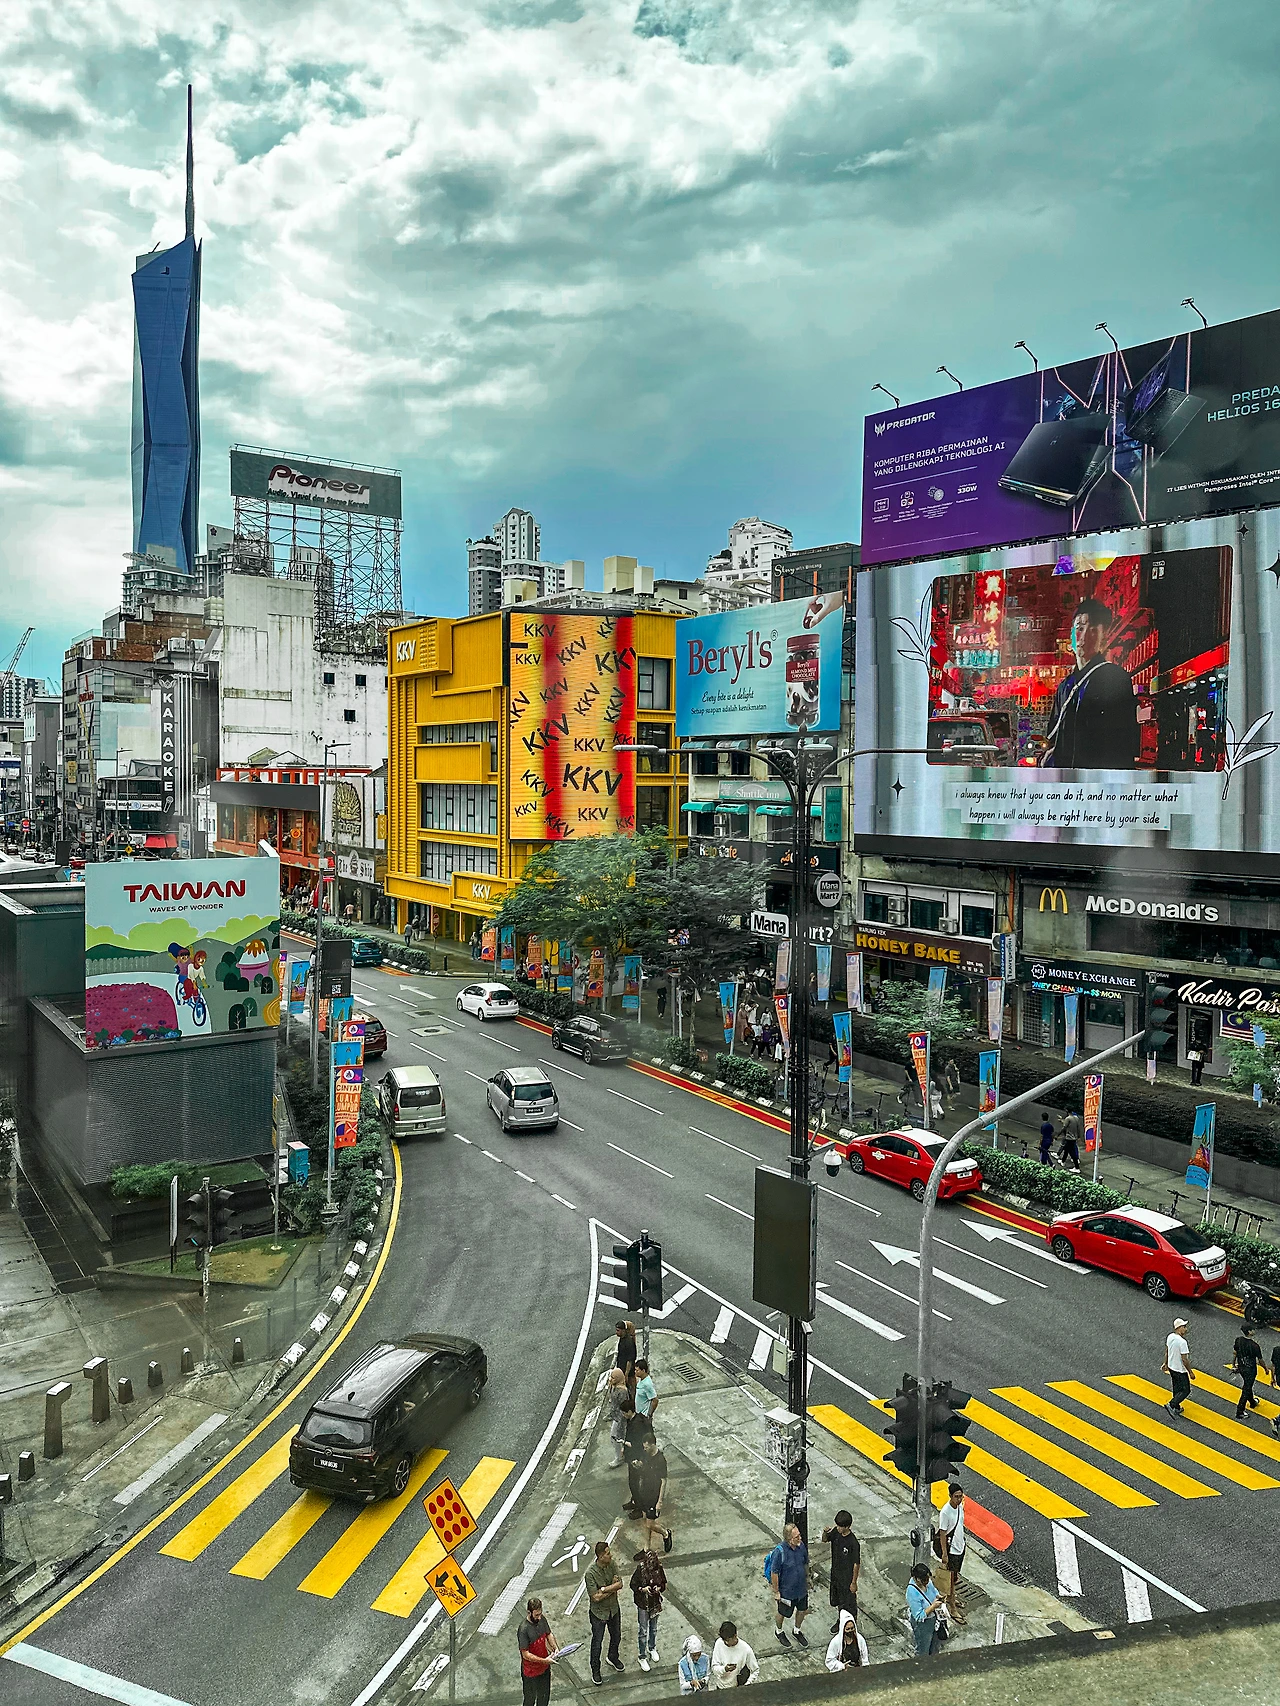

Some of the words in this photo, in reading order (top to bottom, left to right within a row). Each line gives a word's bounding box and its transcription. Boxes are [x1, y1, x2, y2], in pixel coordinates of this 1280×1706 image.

[886, 412, 936, 430] PREDATOR
[1207, 403, 1260, 422] HELIOS
[874, 453, 914, 468] KOMPUTER
[916, 448, 936, 458] RIBA
[938, 436, 988, 454] PERMAINAN
[874, 466, 894, 476] YANG
[895, 456, 944, 472] DILENGKAPI
[945, 444, 992, 461] TEKNOLOGI
[994, 442, 1006, 450] AI
[268, 464, 369, 495] Pioneer
[1204, 483, 1238, 493] Pemproses
[957, 485, 978, 494] 330W
[774, 564, 795, 576] Stay
[524, 624, 556, 637] KKV
[396, 640, 416, 662] KKV
[516, 654, 542, 664] KKV
[556, 636, 586, 666] KKV
[687, 630, 772, 684] Beryl's
[540, 678, 568, 704] KKV
[574, 682, 600, 716] KKV
[702, 690, 717, 704] Every
[717, 690, 726, 702] bite
[728, 692, 732, 700] is
[737, 687, 754, 702] delight
[604, 687, 626, 724] KKV
[162, 692, 174, 792] KARAOKE
[522, 713, 570, 756] KKV
[574, 738, 606, 752] KKV
[520, 769, 554, 798] KKV
[562, 763, 622, 796] KKV
[736, 788, 764, 798] Shuttle
[956, 790, 958, 798] i
[960, 788, 985, 803] always
[988, 788, 1007, 800] knew
[1010, 788, 1026, 799] that
[1029, 791, 1043, 804] you
[1046, 791, 1060, 800] can
[1064, 789, 1074, 800] do
[1076, 789, 1084, 802] it,
[1087, 789, 1103, 801] and
[1105, 791, 1117, 801] no
[1119, 789, 1151, 802] matter
[1155, 789, 1179, 802] what
[514, 801, 537, 818] KKV
[578, 808, 608, 821] KKV
[969, 808, 995, 822] happen
[998, 810, 1001, 819] i
[1003, 809, 1016, 819] will
[1018, 810, 1044, 826] always
[1048, 811, 1057, 821] be
[1060, 811, 1080, 826] right
[1083, 811, 1102, 822] here
[1105, 812, 1116, 827] by
[1119, 814, 1140, 828] your
[1142, 812, 1160, 824] side
[544, 812, 575, 837] KKV
[616, 815, 634, 830] KK
[360, 862, 372, 880] Ship
[123, 880, 246, 903] TAIWAN
[472, 883, 491, 900] KKV
[820, 892, 839, 900] Mart?
[1085, 895, 1219, 922] McDonald's
[856, 933, 910, 954] HONEY
[914, 943, 961, 964] BAKE
[1048, 969, 1082, 980] MONEY
[1082, 972, 1136, 987] EXCHANGE
[1178, 979, 1236, 1007] Kadir
[335, 1102, 358, 1112] UMPUR
